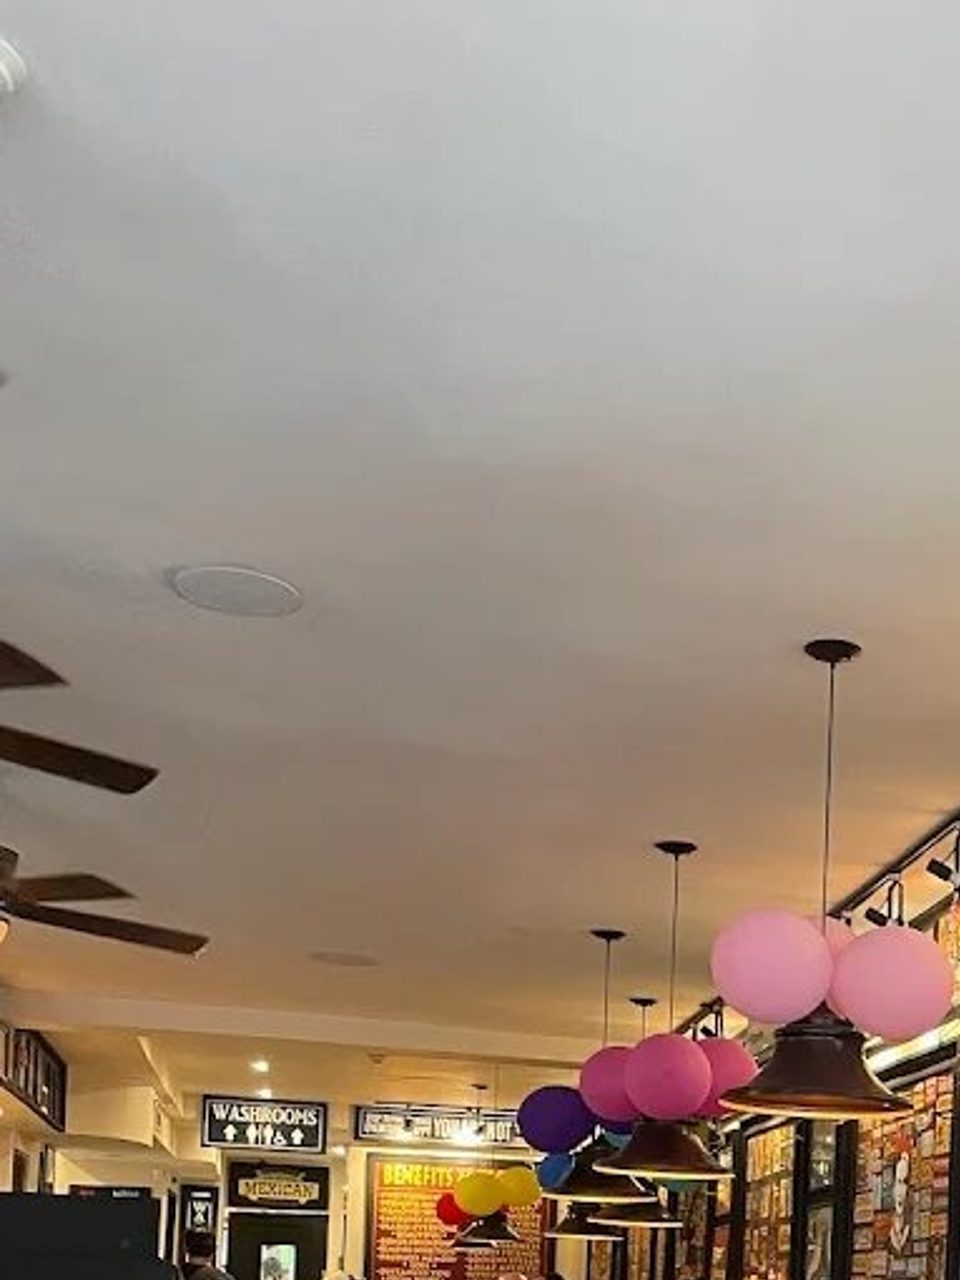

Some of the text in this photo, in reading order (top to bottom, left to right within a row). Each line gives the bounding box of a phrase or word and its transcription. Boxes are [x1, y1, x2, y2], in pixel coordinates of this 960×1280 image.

[212, 1103, 318, 1126] WASHROOMS
[382, 1163, 453, 1187] BENEFITS
[243, 1180, 314, 1199] MEXICAN
